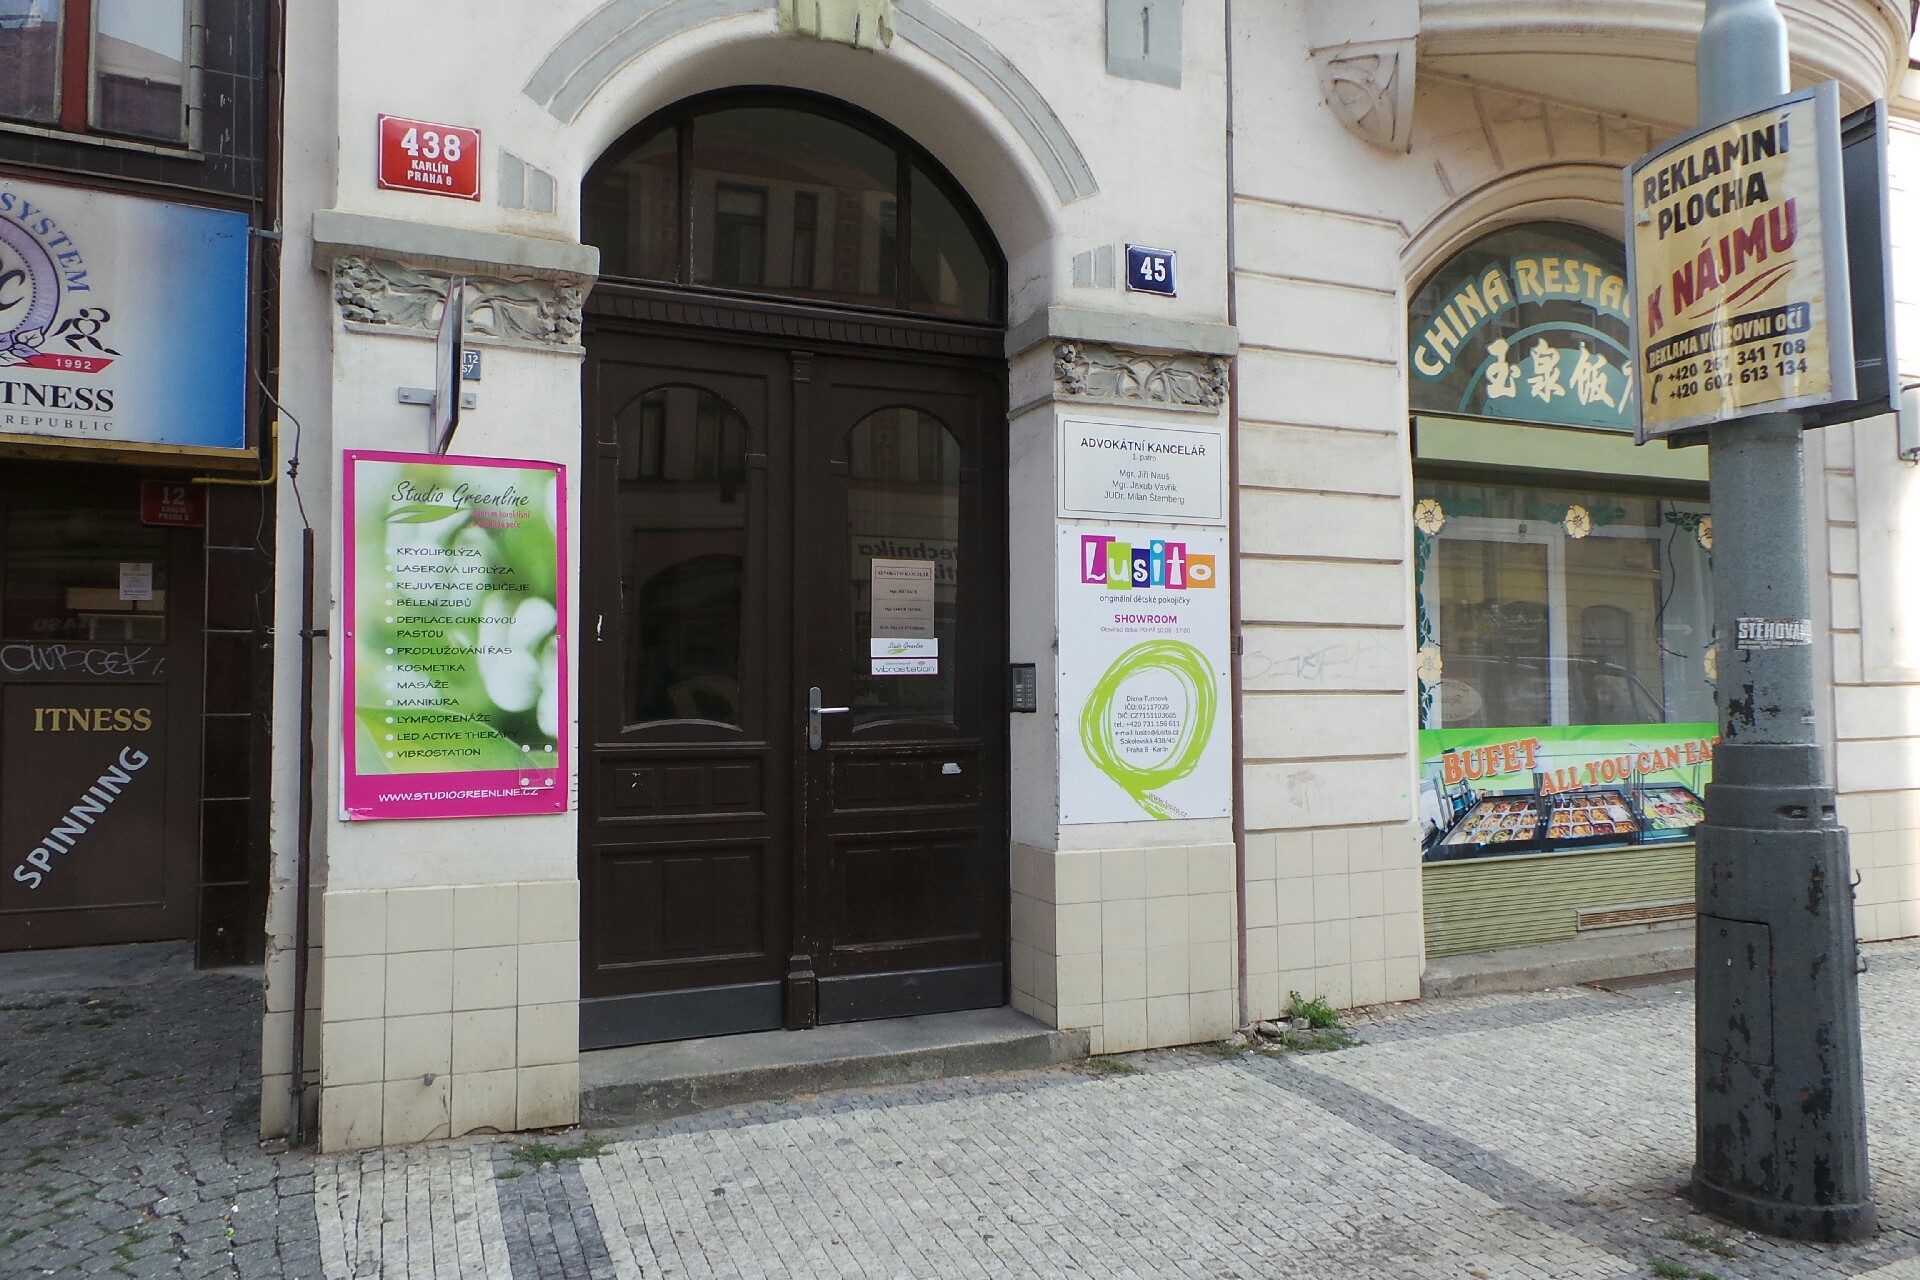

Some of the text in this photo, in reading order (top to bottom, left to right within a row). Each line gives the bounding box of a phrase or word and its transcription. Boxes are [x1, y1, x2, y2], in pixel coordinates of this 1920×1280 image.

[401, 128, 460, 162] 438
[411, 160, 449, 174] KARLÍN
[1644, 113, 1790, 208] REKLAMNÍ
[407, 170, 453, 186] PRAHA 8
[1658, 170, 1769, 241] PLOCHA
[0, 192, 91, 293] SYSTEM
[1140, 256, 1166, 282] 45
[1647, 197, 1798, 338] K NÁJMU
[1414, 269, 1510, 377] CHINA
[1649, 305, 1802, 369] REKLAMA V ÚROVNI OČÍ
[56, 358, 92, 370] 1992
[1668, 362, 1698, 382] +420
[1737, 345, 1766, 366] 341
[1772, 338, 1807, 359] 708
[1670, 357, 1808, 400] +420 602 613 134
[5, 414, 114, 433] REPUBLIC
[1080, 437, 1206, 457] ADVOKÁTNÍ KANCELÁŘ
[1139, 454, 1157, 462] patro
[1119, 469, 1136, 479] Mgr.
[1150, 470, 1170, 480] Nauš
[1112, 480, 1129, 490] Mgr.
[1130, 481, 1153, 490] Jakub
[162, 486, 186, 506] 12
[391, 480, 530, 511] Studio Greenline
[1104, 491, 1125, 500] JUDr.
[1127, 492, 1148, 501] Milan
[396, 547, 482, 557] KRYOLIPOLÝZA
[396, 564, 515, 575] LASEROVÁ LIPOLÝZA
[1085, 542, 1213, 586] Lusito
[396, 581, 531, 591] REJUVENACE OBLIČEJE
[396, 597, 472, 607] BĚLENÍ ZUBŮ
[1099, 594, 1132, 603] originální
[1158, 596, 1191, 606] pokojíčky
[396, 616, 517, 624] DEPILACE CUKROVOU
[1114, 614, 1178, 624] SHOWROOM
[396, 629, 444, 638] PASTOU
[396, 645, 513, 655] PRODLUŽOVÁNÍ ŘAS
[396, 664, 466, 672] KOSMETIKA
[396, 679, 449, 689] MASÁŽE
[396, 698, 460, 706] MANIKURA
[33, 708, 153, 732] ITNESS
[396, 714, 492, 724] LYMFODRENÁŽE
[396, 730, 518, 741] LED ACTIVE THERAPY
[396, 748, 481, 758] VIBROSTATION
[1441, 737, 1540, 786] BUFET
[1540, 768, 1583, 797] ALL
[1585, 754, 1631, 786] YOU
[1636, 744, 1681, 775] CAN
[378, 788, 539, 802] WWW.STUDIOGREENLINE.CZ
[13, 745, 149, 890] SPINNING
